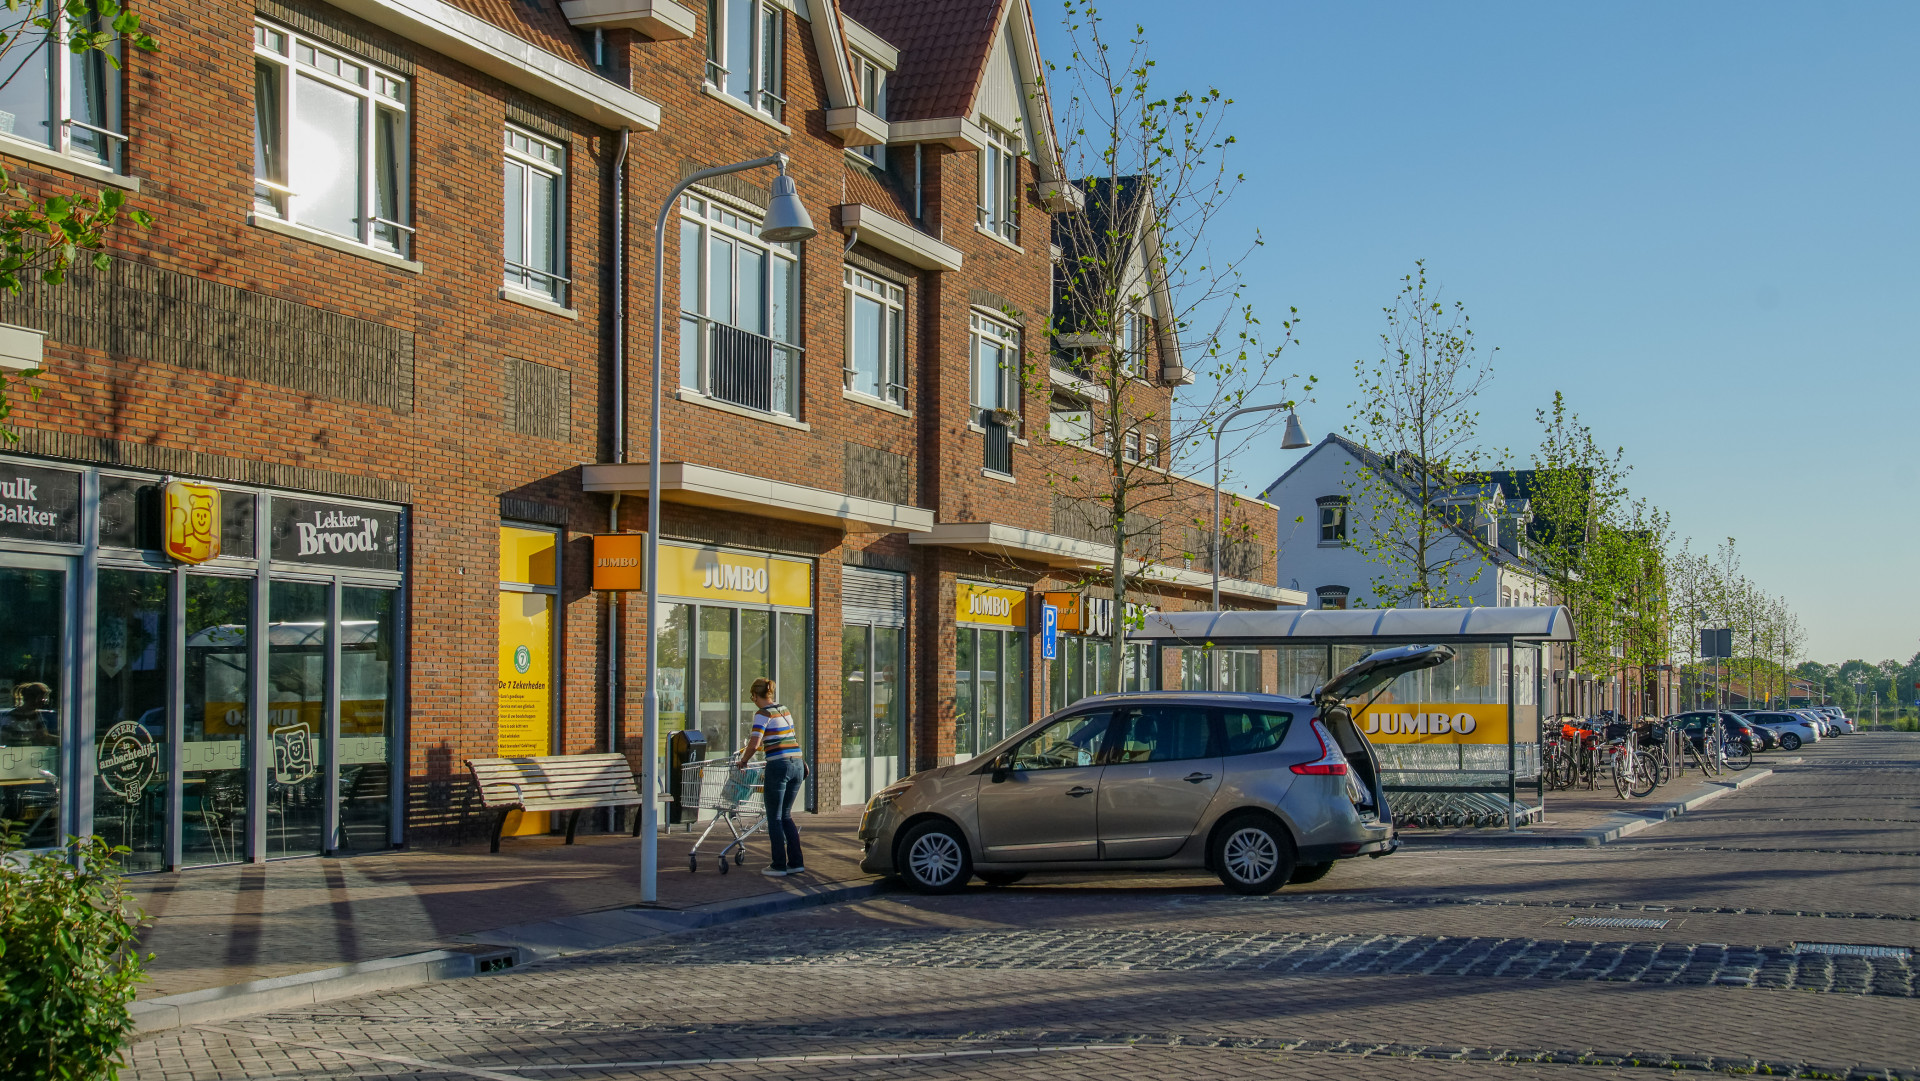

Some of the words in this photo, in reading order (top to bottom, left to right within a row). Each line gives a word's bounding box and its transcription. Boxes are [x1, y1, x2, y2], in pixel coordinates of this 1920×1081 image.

[0, 477, 38, 501] ulk
[315, 510, 361, 529] Lekker
[296, 517, 379, 556] Brood!
[597, 557, 639, 568] JUMBO
[702, 561, 769, 594] JUMBO
[968, 593, 1011, 618] JUMBO
[1057, 606, 1078, 616] MBO
[1045, 608, 1055, 637] P
[520, 654, 525, 665] 7
[498, 680, 507, 689] De
[508, 681, 512, 689] 7
[512, 680, 546, 690] Zekerheden
[110, 724, 138, 741] STERK
[1364, 712, 1477, 735] JUMBO
[99, 743, 157, 770] ambachtelijk
[121, 760, 138, 772] werk
